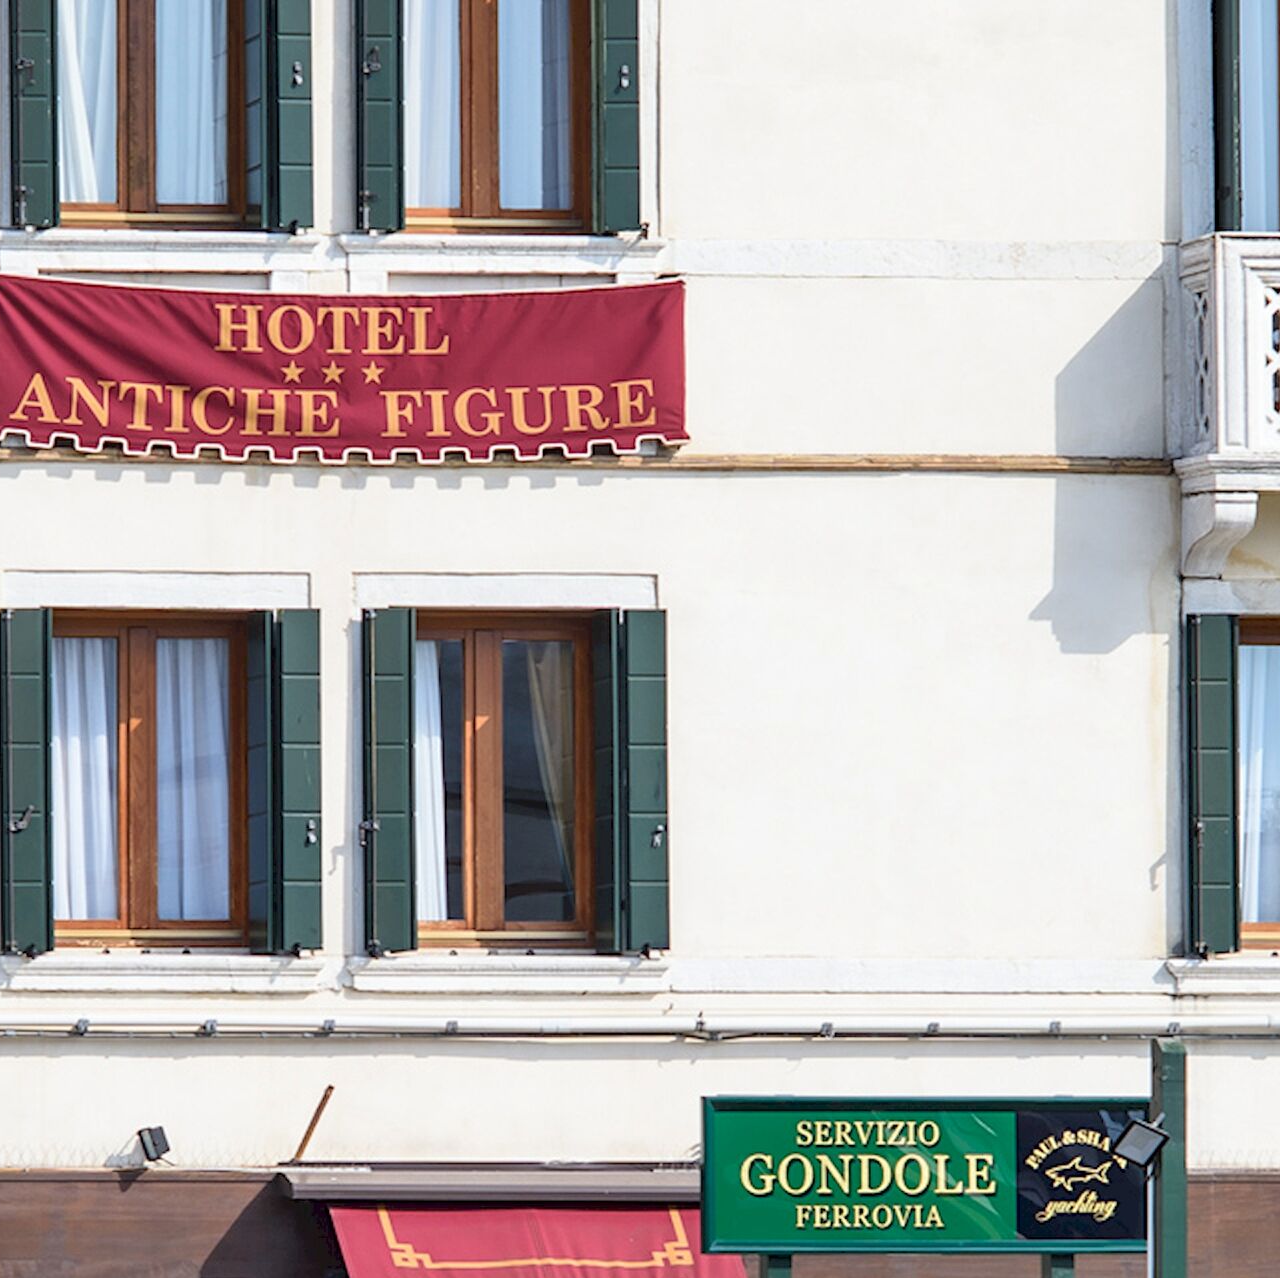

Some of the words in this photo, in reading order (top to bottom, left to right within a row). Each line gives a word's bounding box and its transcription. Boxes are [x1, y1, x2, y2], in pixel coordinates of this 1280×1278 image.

[216, 304, 450, 354] HOTEL
[10, 372, 340, 437] ANTICHE
[381, 379, 655, 437] FIGURE
[796, 1121, 940, 1146] SERVIZIO
[740, 1153, 996, 1195] GONDOLE
[796, 1205, 944, 1229] FERROVIA
[1035, 1190, 1117, 1222] yachting
